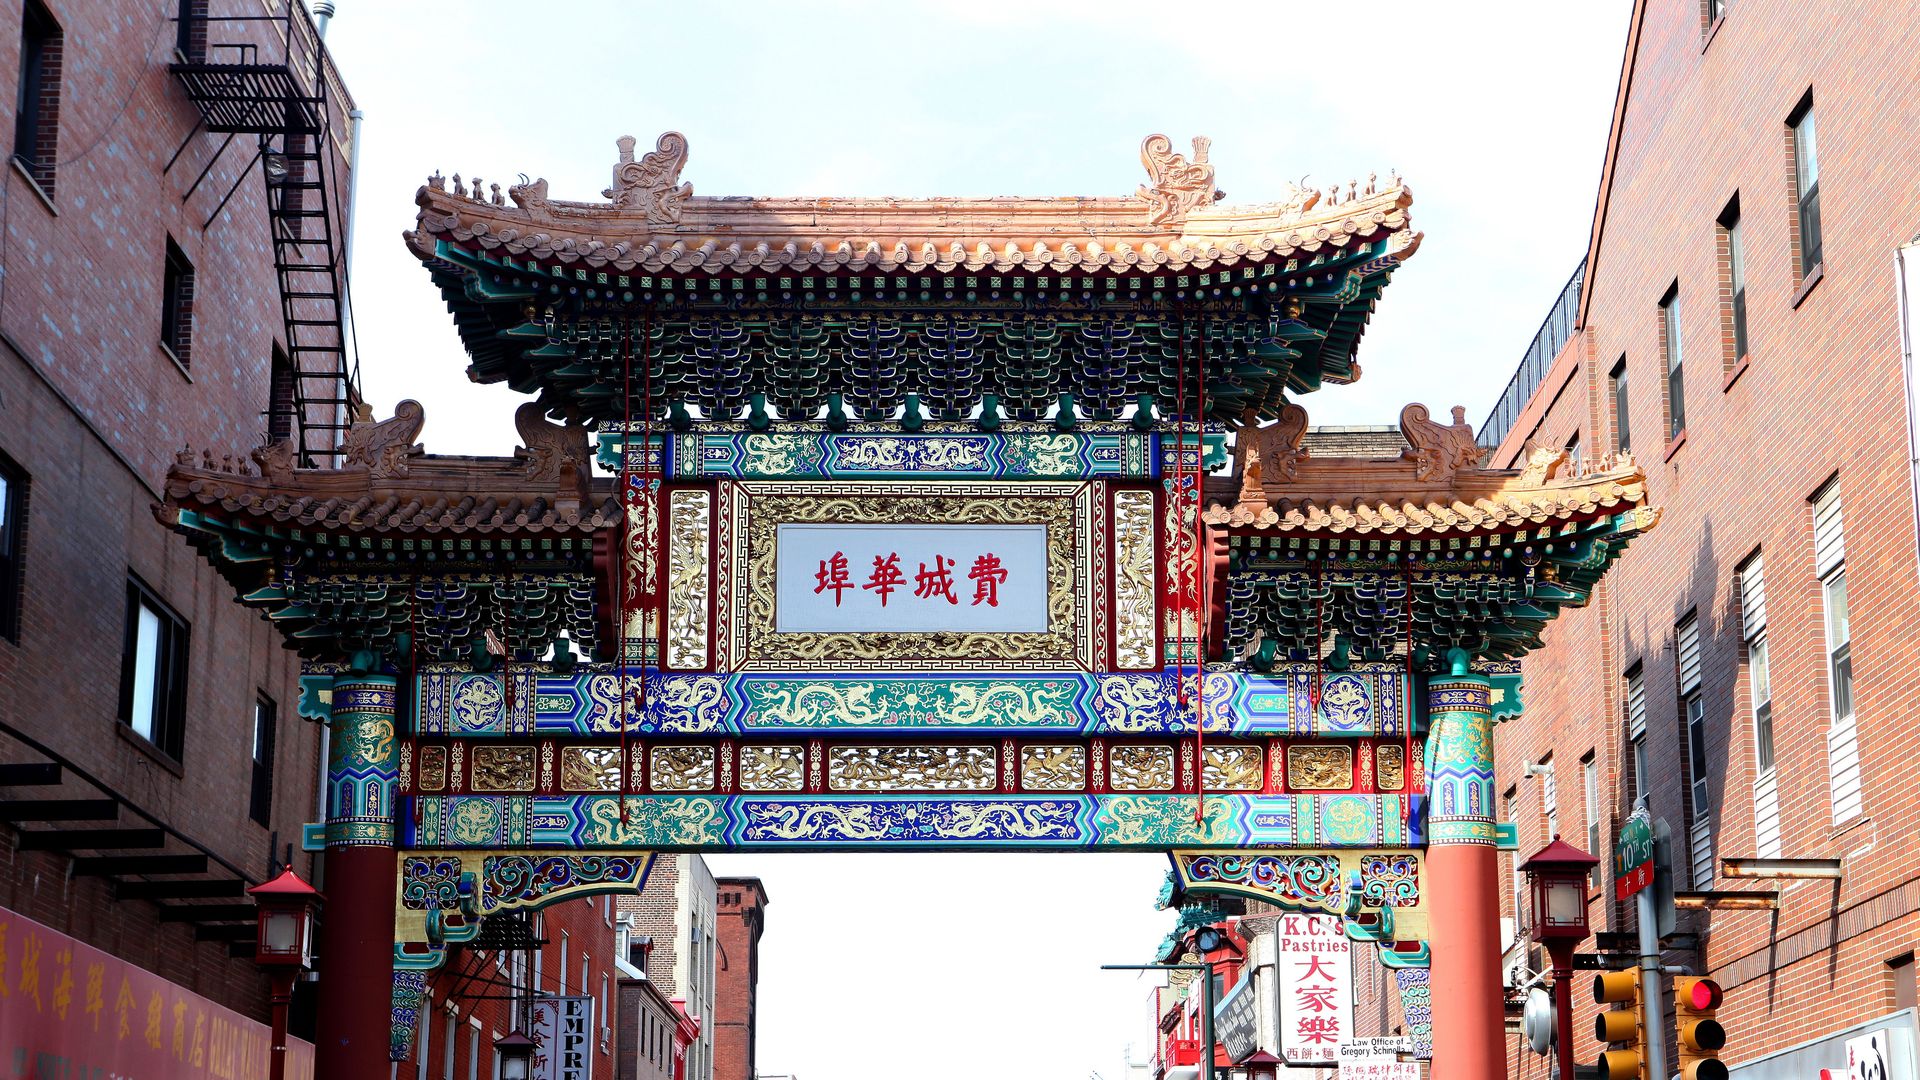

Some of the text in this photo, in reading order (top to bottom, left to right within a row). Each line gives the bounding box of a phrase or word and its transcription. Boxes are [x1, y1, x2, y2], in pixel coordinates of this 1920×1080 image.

[1642, 839, 1650, 859] ST
[1284, 916, 1344, 936] K.C.'s
[1281, 938, 1349, 952] Pastries
[1295, 955, 1340, 1045] 大家樂
[1352, 1037, 1404, 1047] Law Office of
[1341, 1046, 1371, 1057] Gregory
